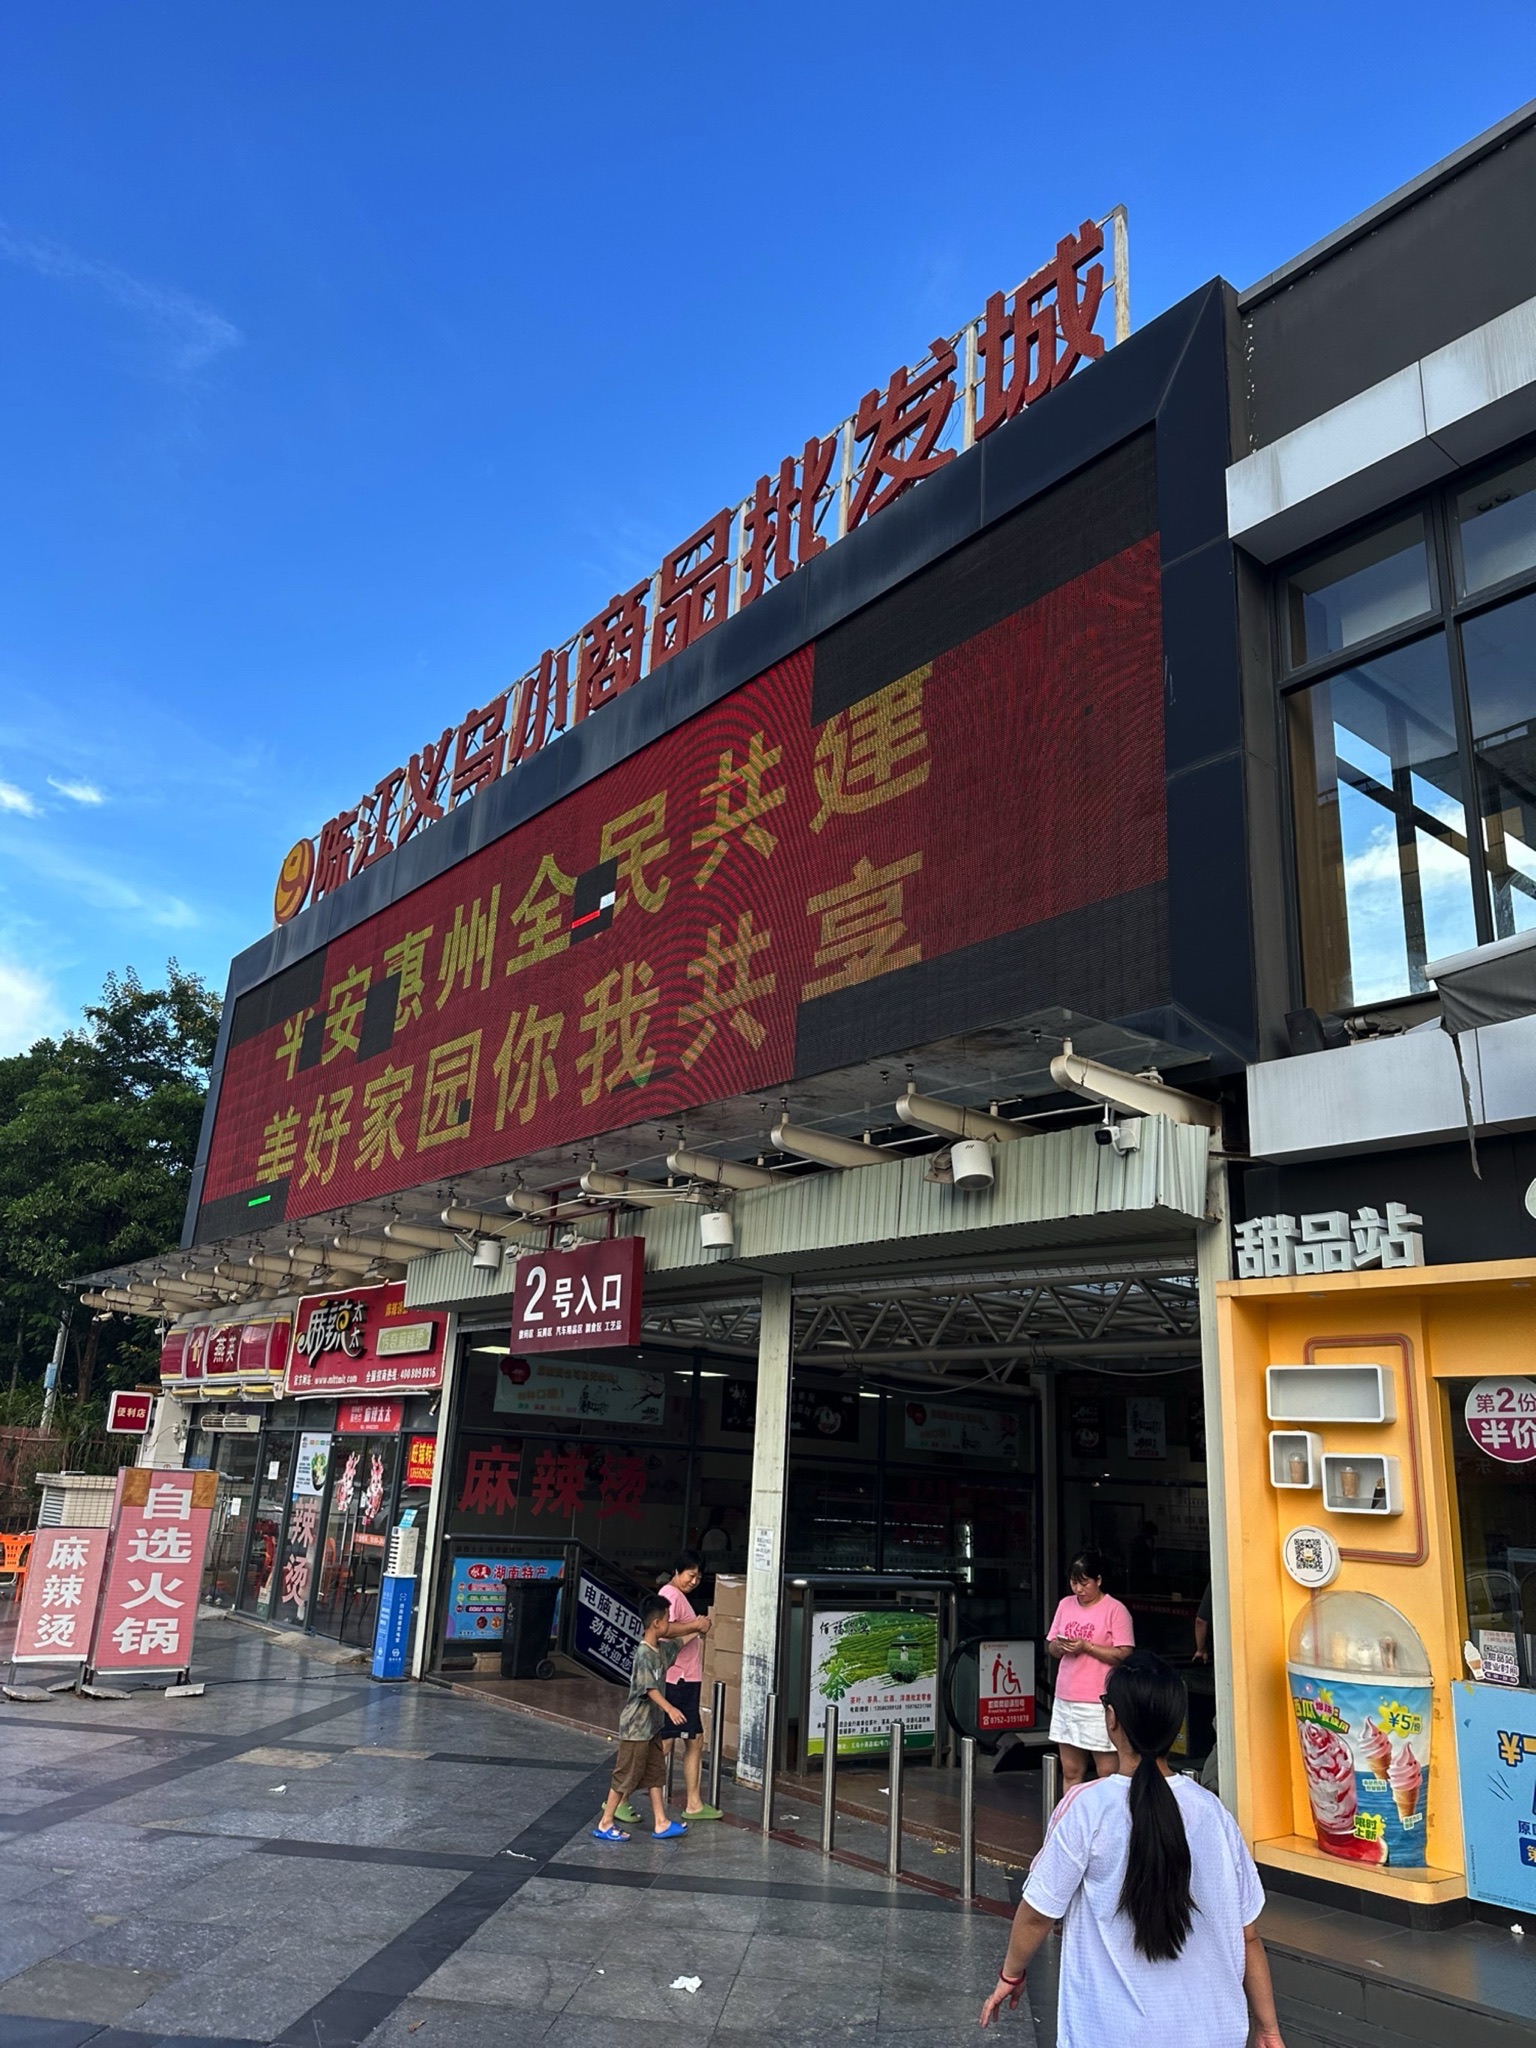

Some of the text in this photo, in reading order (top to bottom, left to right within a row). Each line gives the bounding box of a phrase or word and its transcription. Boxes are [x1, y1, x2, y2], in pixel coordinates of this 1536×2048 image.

[312, 219, 1104, 896] 陈江义乌小商品批发城
[256, 851, 922, 1190] 美好家园你我共享
[1234, 1202, 1425, 1279] 甜品站
[523, 1265, 622, 1322] 2号入口
[117, 1407, 146, 1418] 便利店
[1480, 1420, 1536, 1449] 半价
[457, 1445, 648, 1521] 麻辣烫
[33, 1536, 89, 1649] 麻辣烫
[112, 1483, 193, 1655] 自选火锅
[1354, 1828, 1377, 1841] 上新
[1355, 1816, 1377, 1830] 限时
